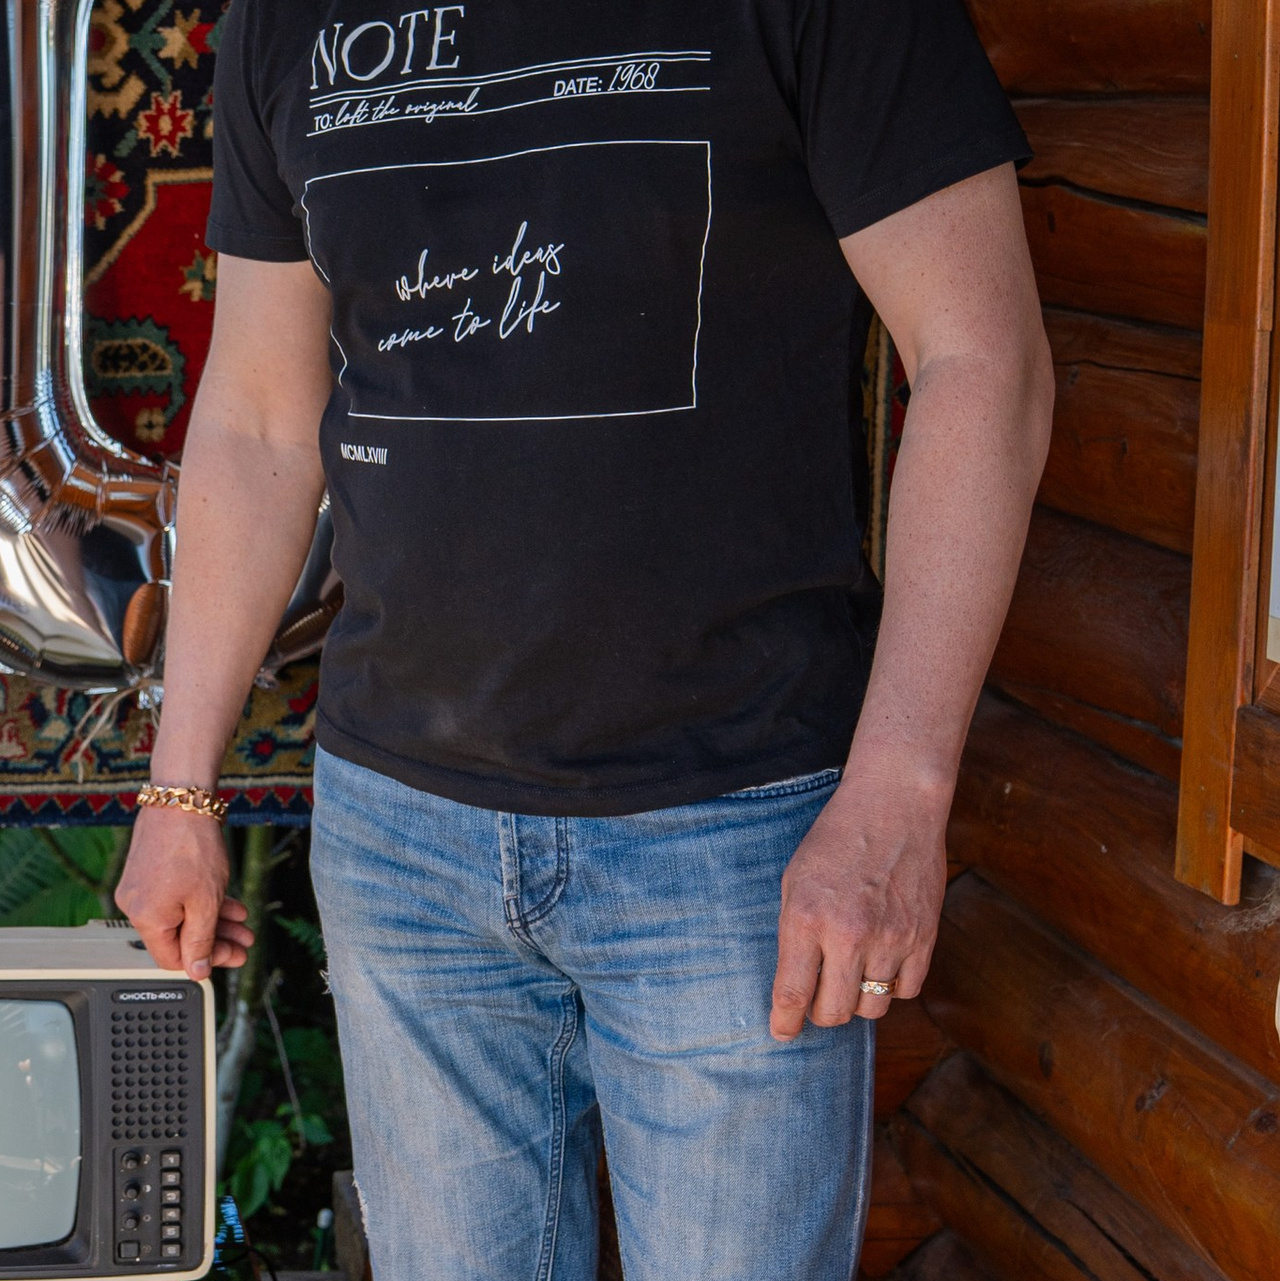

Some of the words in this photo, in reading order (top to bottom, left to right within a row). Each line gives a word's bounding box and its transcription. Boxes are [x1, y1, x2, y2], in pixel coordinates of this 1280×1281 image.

[310, 5, 465, 89] NOTE
[314, 113, 333, 131] TO:
[335, 100, 369, 127] loft
[372, 95, 400, 121] the
[405, 87, 481, 123] original
[553, 76, 603, 97] DATE:
[607, 62, 660, 92] 1968
[395, 248, 479, 301] where
[493, 221, 565, 276] ideas
[378, 326, 444, 352] come
[452, 297, 491, 343] to
[500, 271, 561, 340] life
[340, 442, 388, 465] MCMLXVIII
